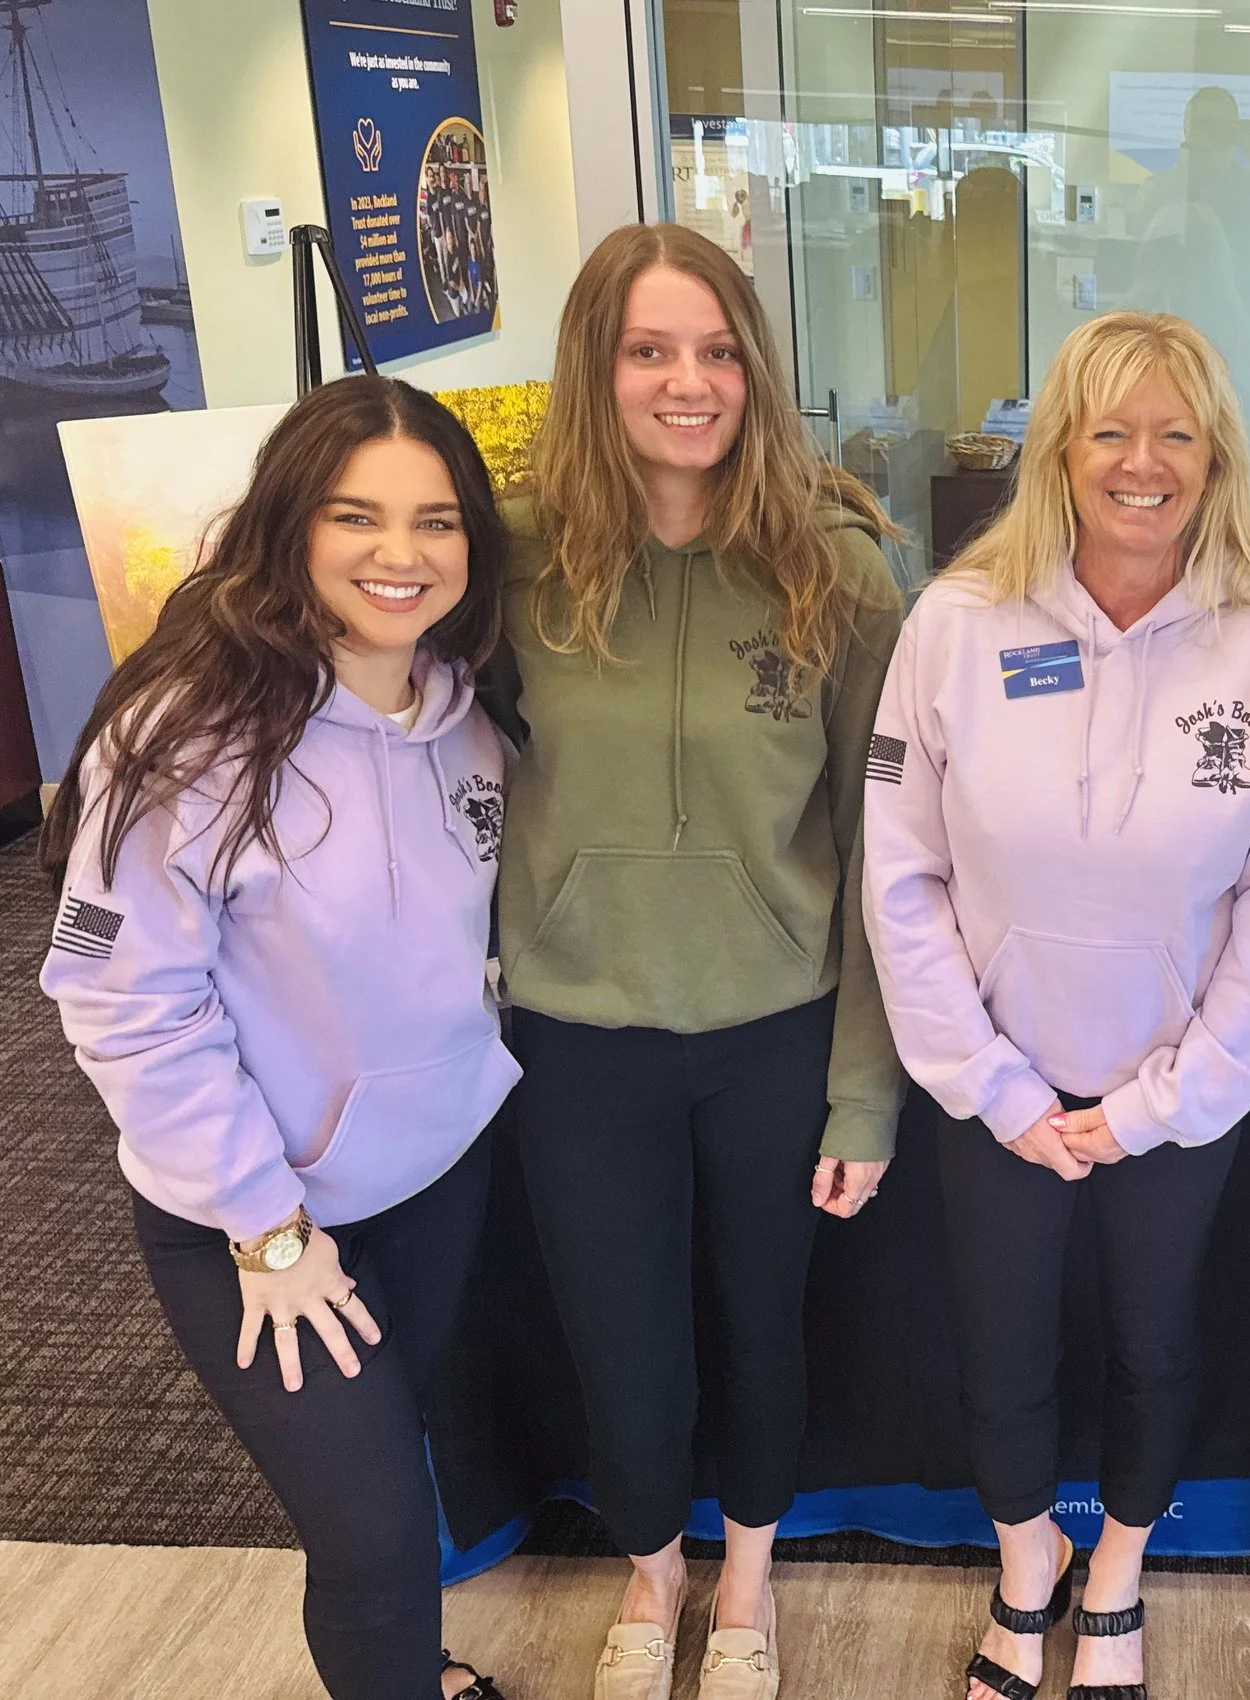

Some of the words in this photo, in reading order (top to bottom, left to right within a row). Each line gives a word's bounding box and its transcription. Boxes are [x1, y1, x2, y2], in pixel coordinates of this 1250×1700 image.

[692, 117, 745, 130] Ivestme
[351, 216, 366, 230] Trust
[387, 231, 397, 244] and
[393, 249, 406, 262] than
[381, 270, 397, 283] hours
[1004, 648, 1040, 659] ROCKLAND
[1030, 675, 1059, 687] Becky
[1175, 700, 1224, 734] Josh's
[472, 774, 503, 796] Boo
[1050, 1498, 1104, 1515] emb
